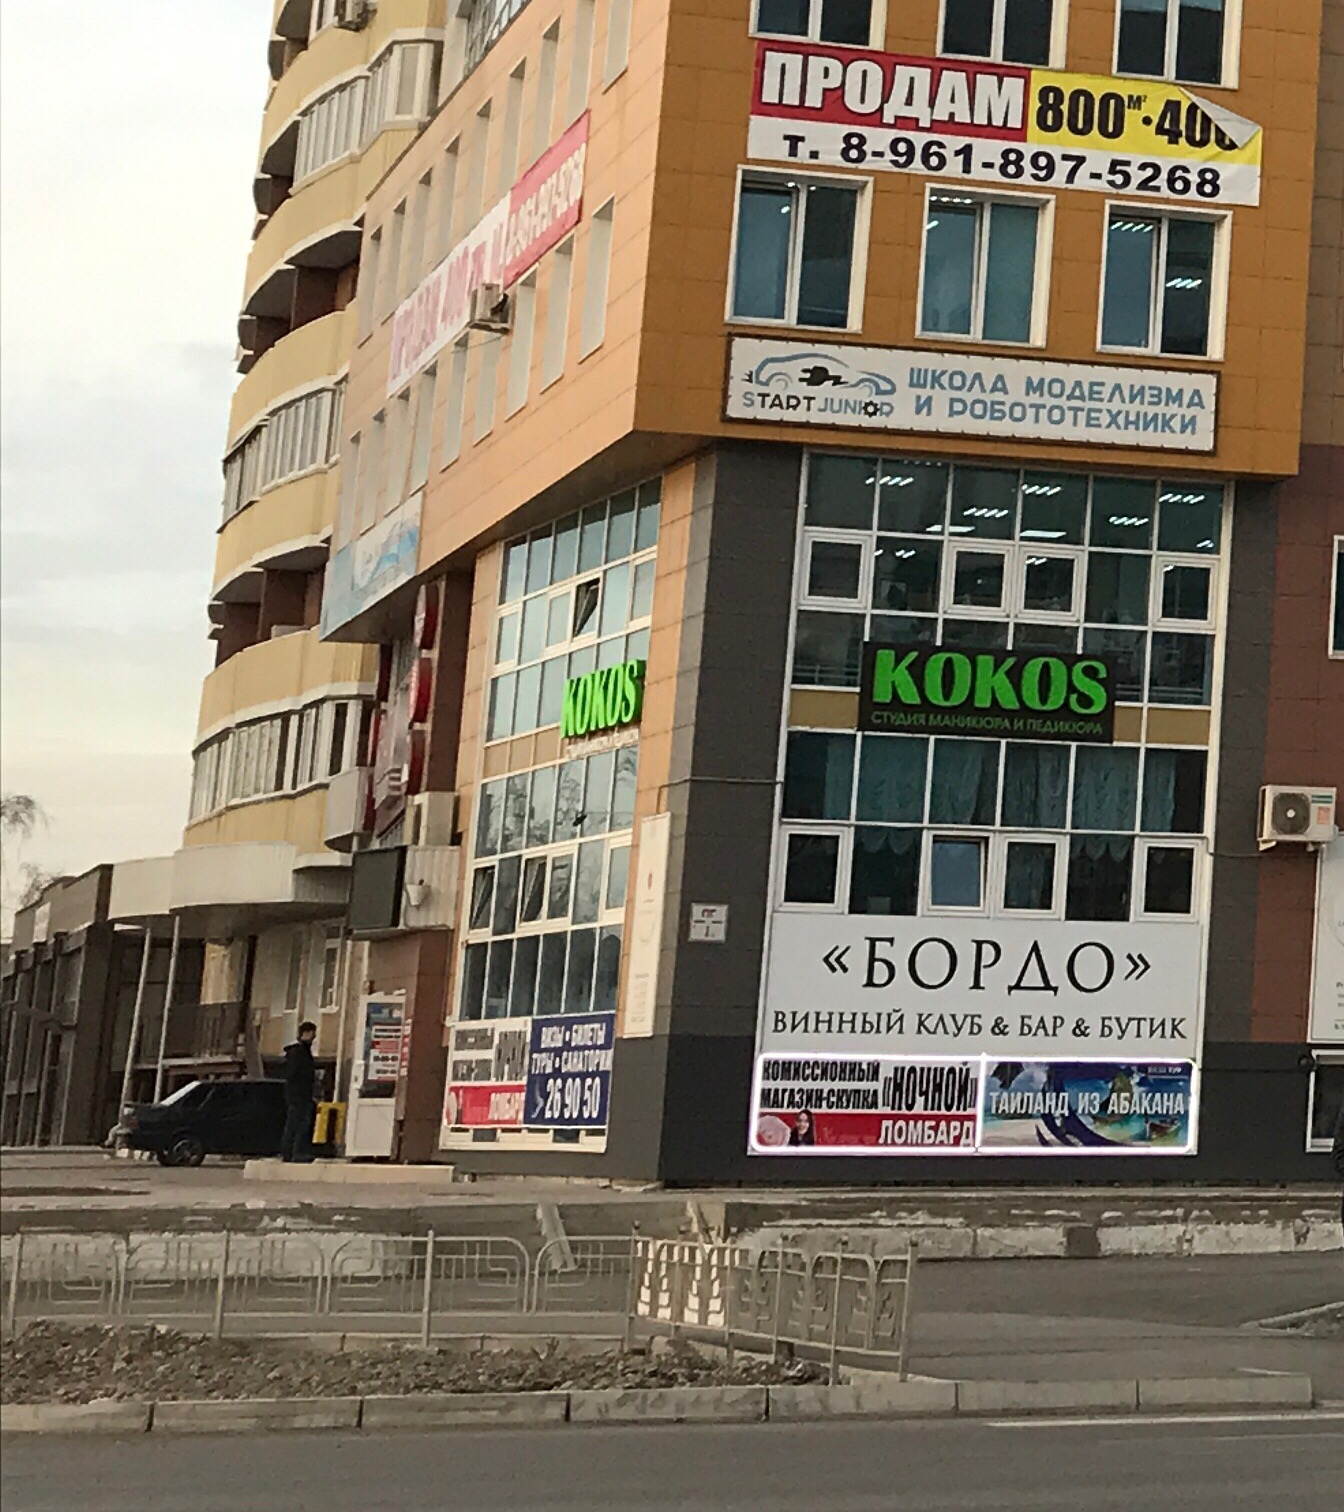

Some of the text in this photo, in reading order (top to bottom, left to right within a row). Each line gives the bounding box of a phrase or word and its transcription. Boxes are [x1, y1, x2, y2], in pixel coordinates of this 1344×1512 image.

[762, 51, 1025, 129] ПРОДАМ
[841, 131, 1222, 199] 8-961-897-5268
[909, 366, 1207, 410] ШКОЛА МОДЕЛИЗМА
[914, 395, 1198, 436] И РОБОТОТЕХНИКИ
[560, 659, 645, 739] KOKOS
[872, 649, 1108, 715] KOKOS
[871, 711, 1103, 735] СТУДИЯ МАНИКЮРА И ПЕДИКЮРА
[822, 936, 1152, 997] «БОРДО»
[772, 1008, 1188, 1040] ВИННЫЙ КЛУБ & БАР & БУТИК
[762, 1059, 881, 1083] КОМИССИОННЫЙ
[544, 1076, 601, 1120] 26 90 50
[761, 1086, 879, 1110] МАГАЗИН-СКУПКА
[1077, 1092, 1101, 1115] ИЗ
[1107, 1092, 1186, 1116] АБАКАНА
[878, 1119, 975, 1147] ЛОМБАРД
